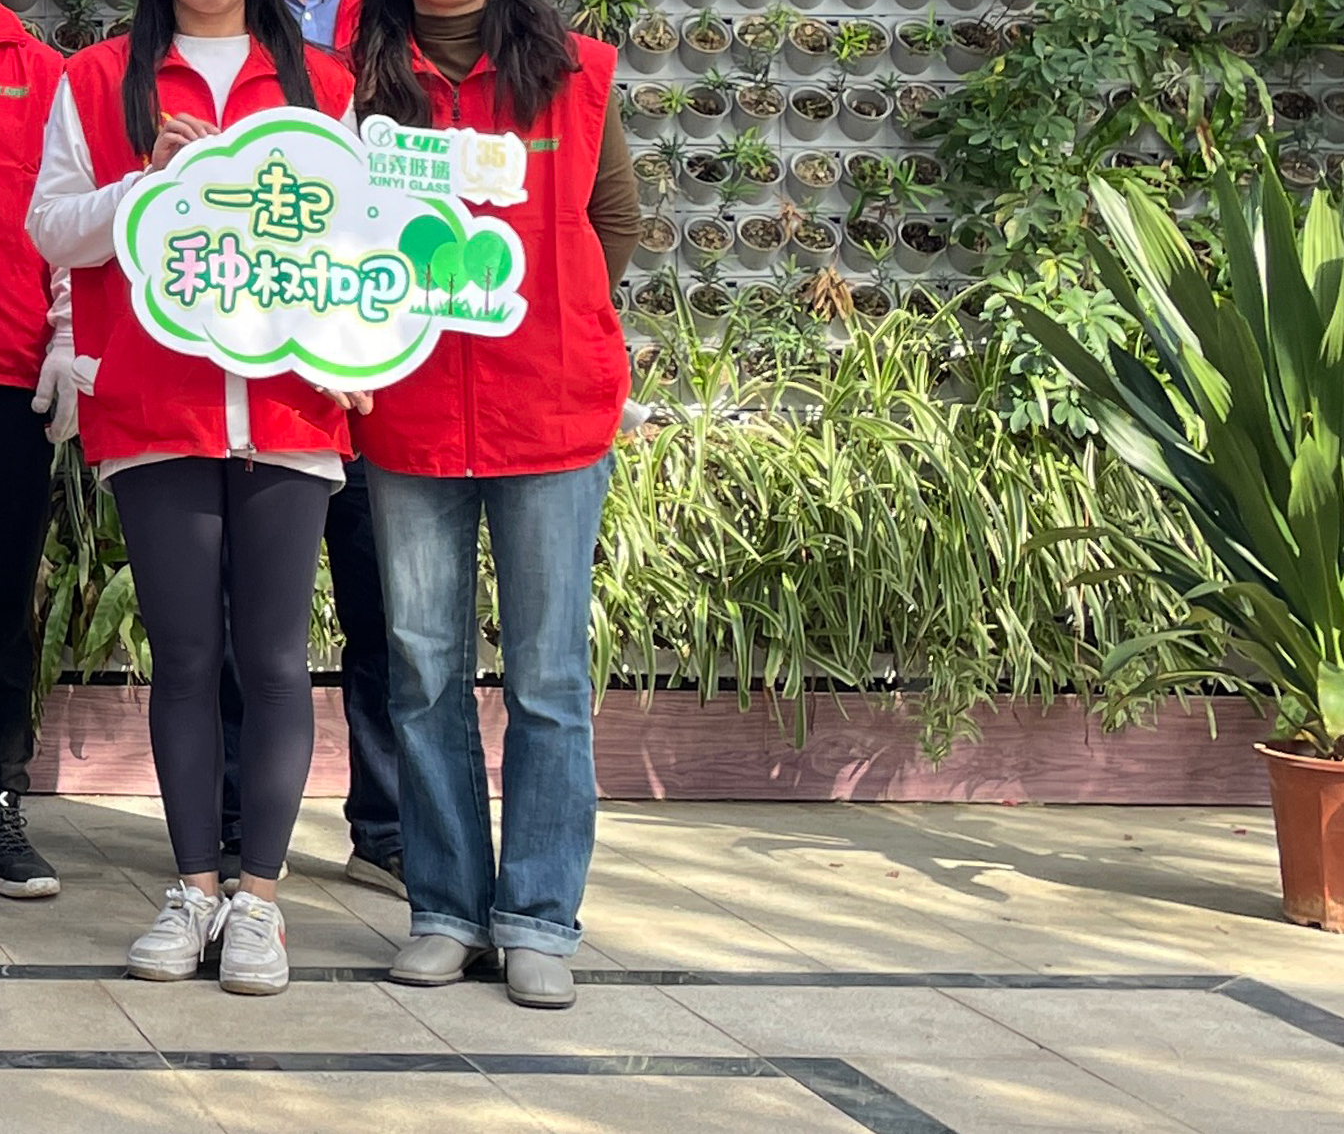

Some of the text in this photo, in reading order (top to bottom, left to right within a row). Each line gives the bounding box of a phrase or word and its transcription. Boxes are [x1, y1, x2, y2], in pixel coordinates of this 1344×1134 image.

[391, 132, 451, 154] XYG
[477, 141, 508, 168] 35
[368, 174, 451, 194] XINYI GLASS
[204, 162, 334, 242] 一起
[165, 231, 410, 323] 种树吧
